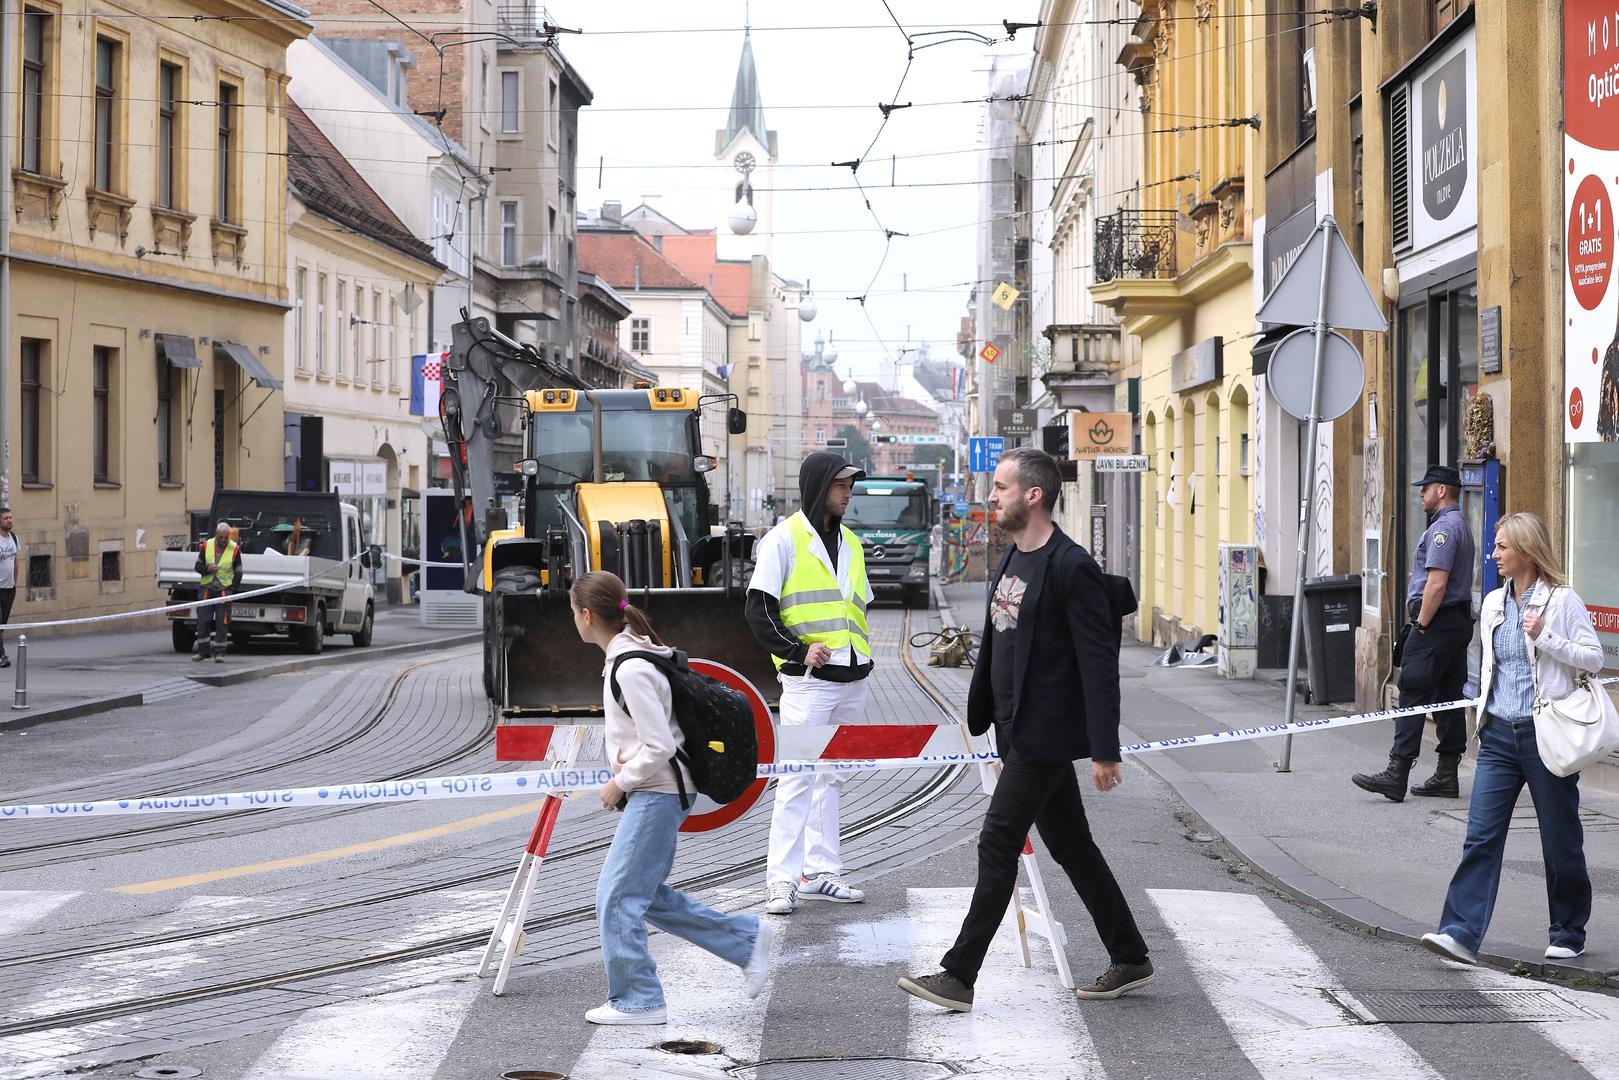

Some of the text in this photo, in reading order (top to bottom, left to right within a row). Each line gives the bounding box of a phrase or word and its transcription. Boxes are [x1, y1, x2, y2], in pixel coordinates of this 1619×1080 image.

[1424, 127, 1465, 184] POLZELA
[1579, 198, 1602, 235] 1+1
[1579, 238, 1602, 256] GRATIS
[1002, 291, 1008, 299] 5
[989, 442, 1003, 450] TRAM
[1097, 457, 1147, 469] JAVNI BILJEŽNIK
